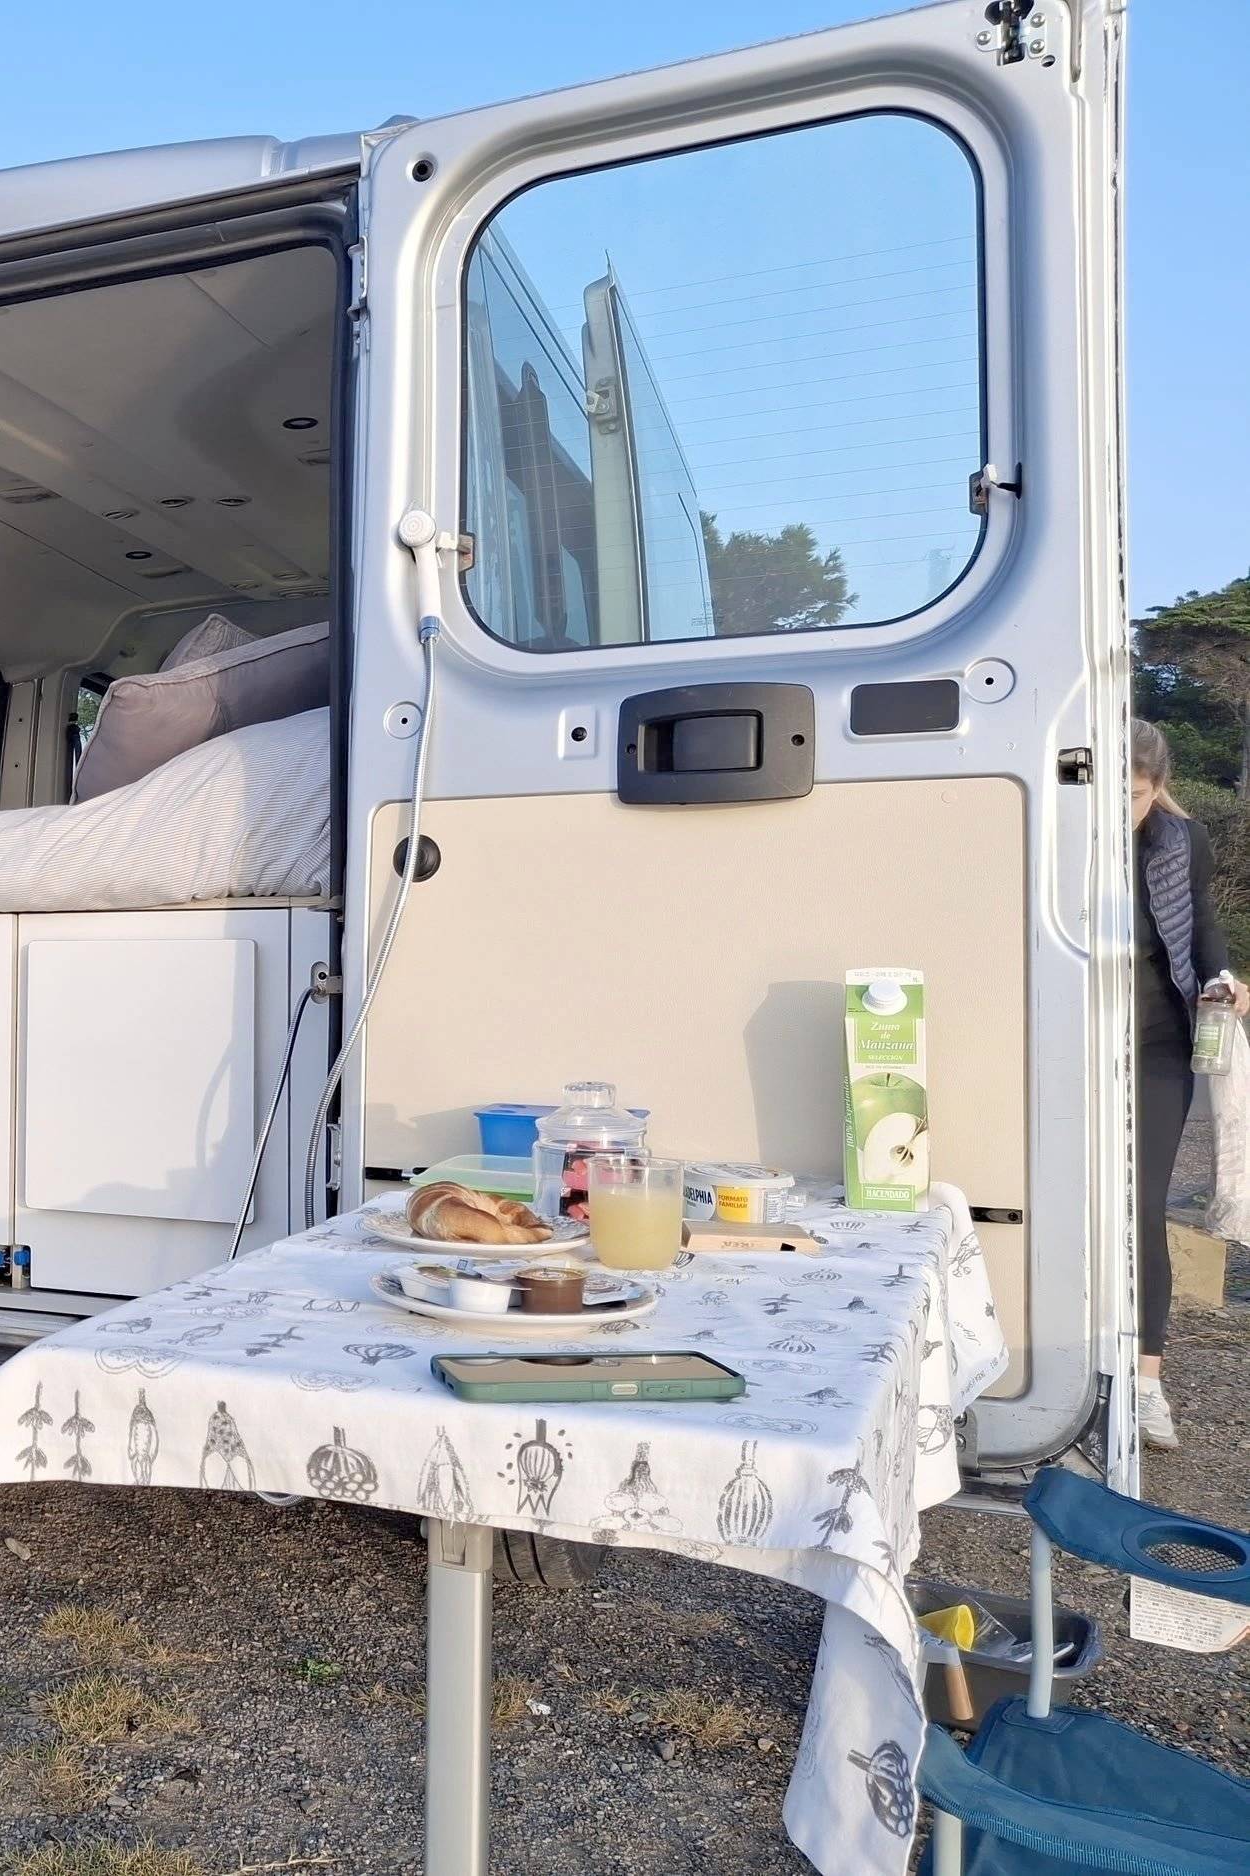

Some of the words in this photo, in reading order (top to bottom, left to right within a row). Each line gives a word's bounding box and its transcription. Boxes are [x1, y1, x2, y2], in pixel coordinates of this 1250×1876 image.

[880, 1031, 891, 1039] de
[858, 1039, 914, 1050] Manzana
[718, 1194, 748, 1203] FORMATO
[866, 1189, 911, 1199] HACENDADO
[719, 1201, 748, 1209] FAMILIAR
